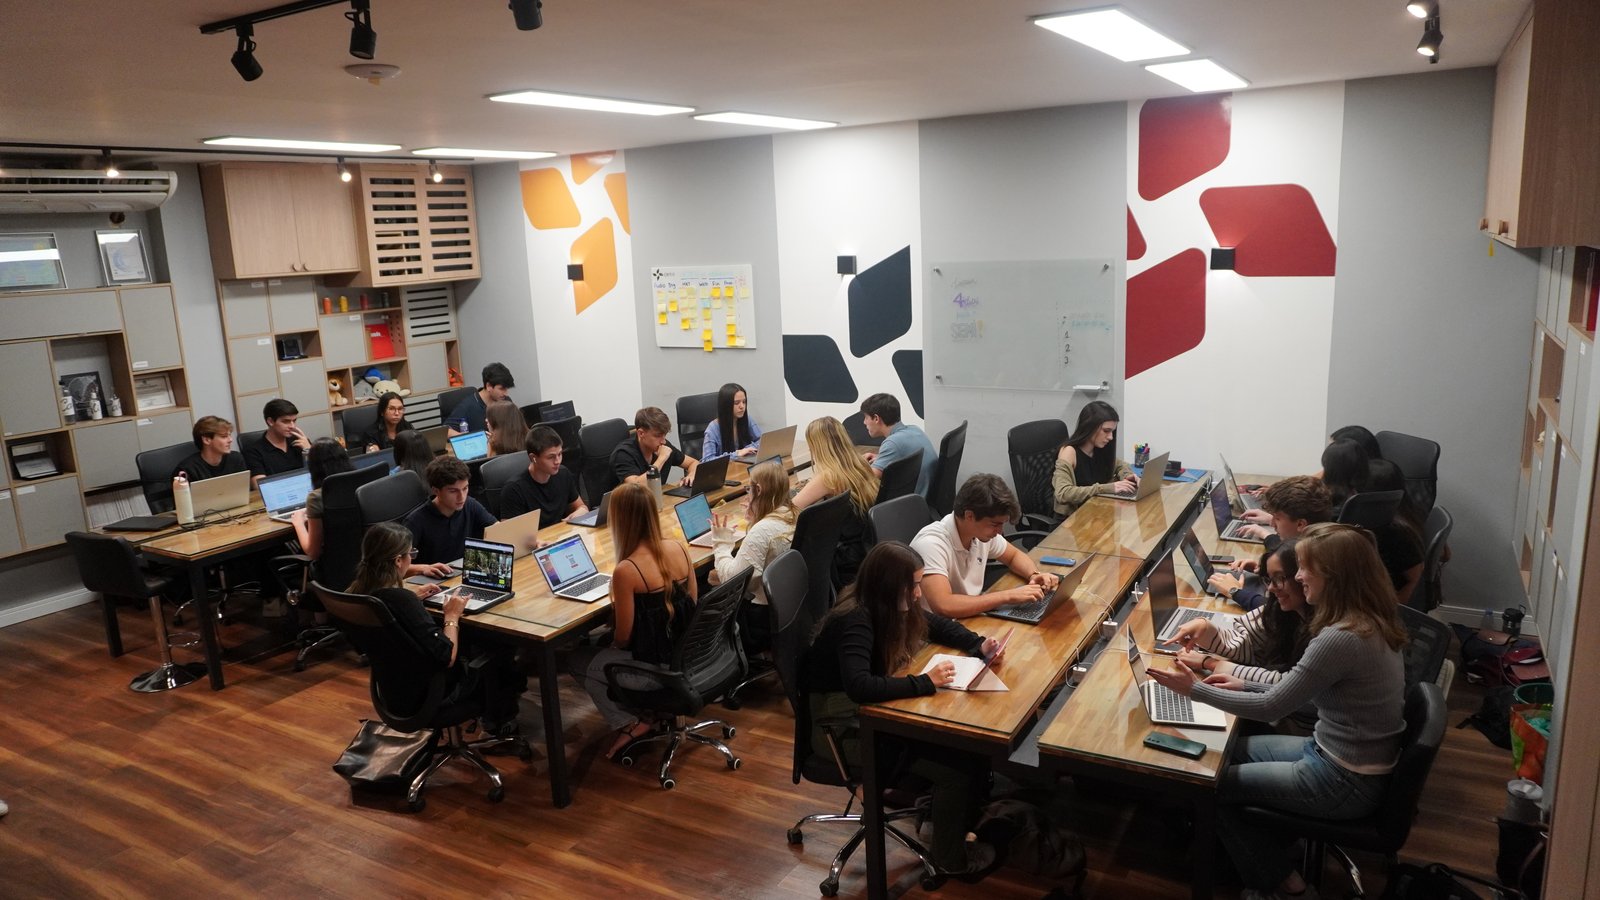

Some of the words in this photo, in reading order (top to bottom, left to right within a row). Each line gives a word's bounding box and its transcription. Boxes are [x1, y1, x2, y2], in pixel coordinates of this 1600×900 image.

[1064, 330, 1070, 339] 1
[1065, 343, 1071, 352] 2
[1063, 356, 1069, 364] 3
